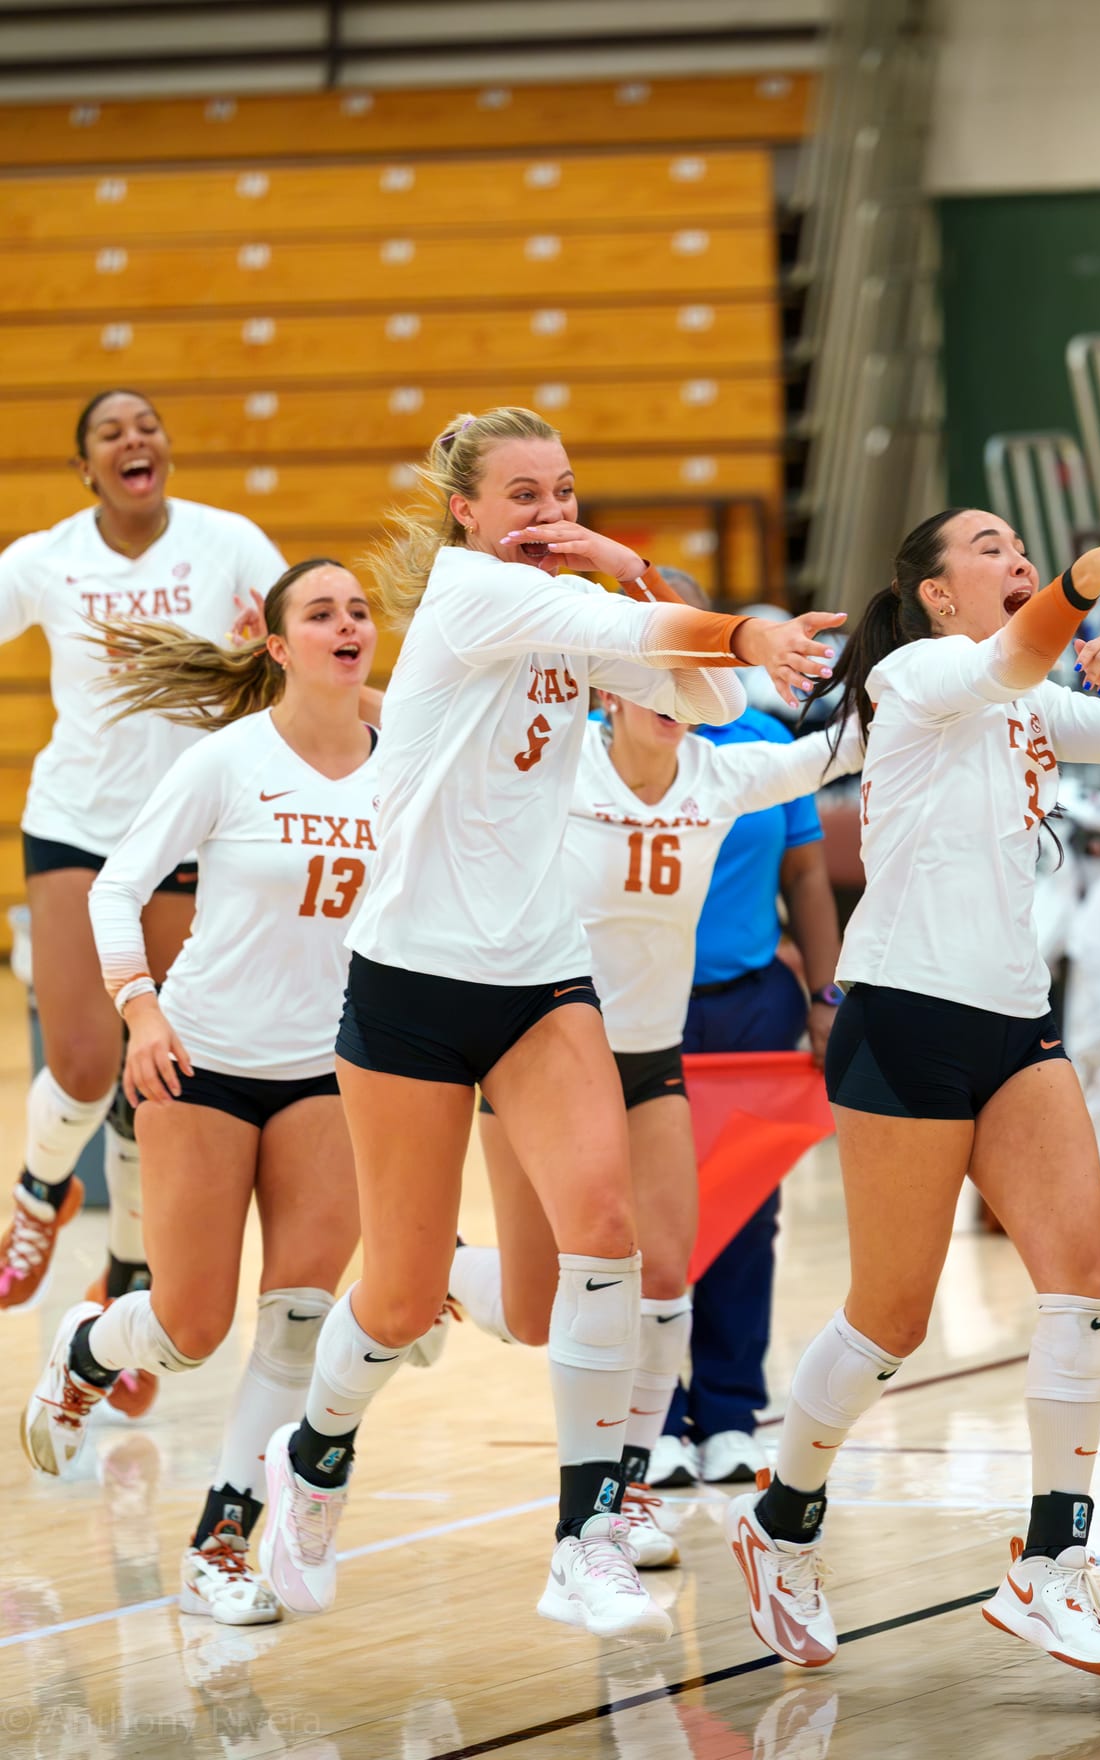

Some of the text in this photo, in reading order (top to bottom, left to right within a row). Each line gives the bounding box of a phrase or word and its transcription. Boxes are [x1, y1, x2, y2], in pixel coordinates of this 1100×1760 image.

[80, 584, 193, 620] TEXAS
[298, 854, 367, 919] 13
[623, 831, 683, 897] 16
